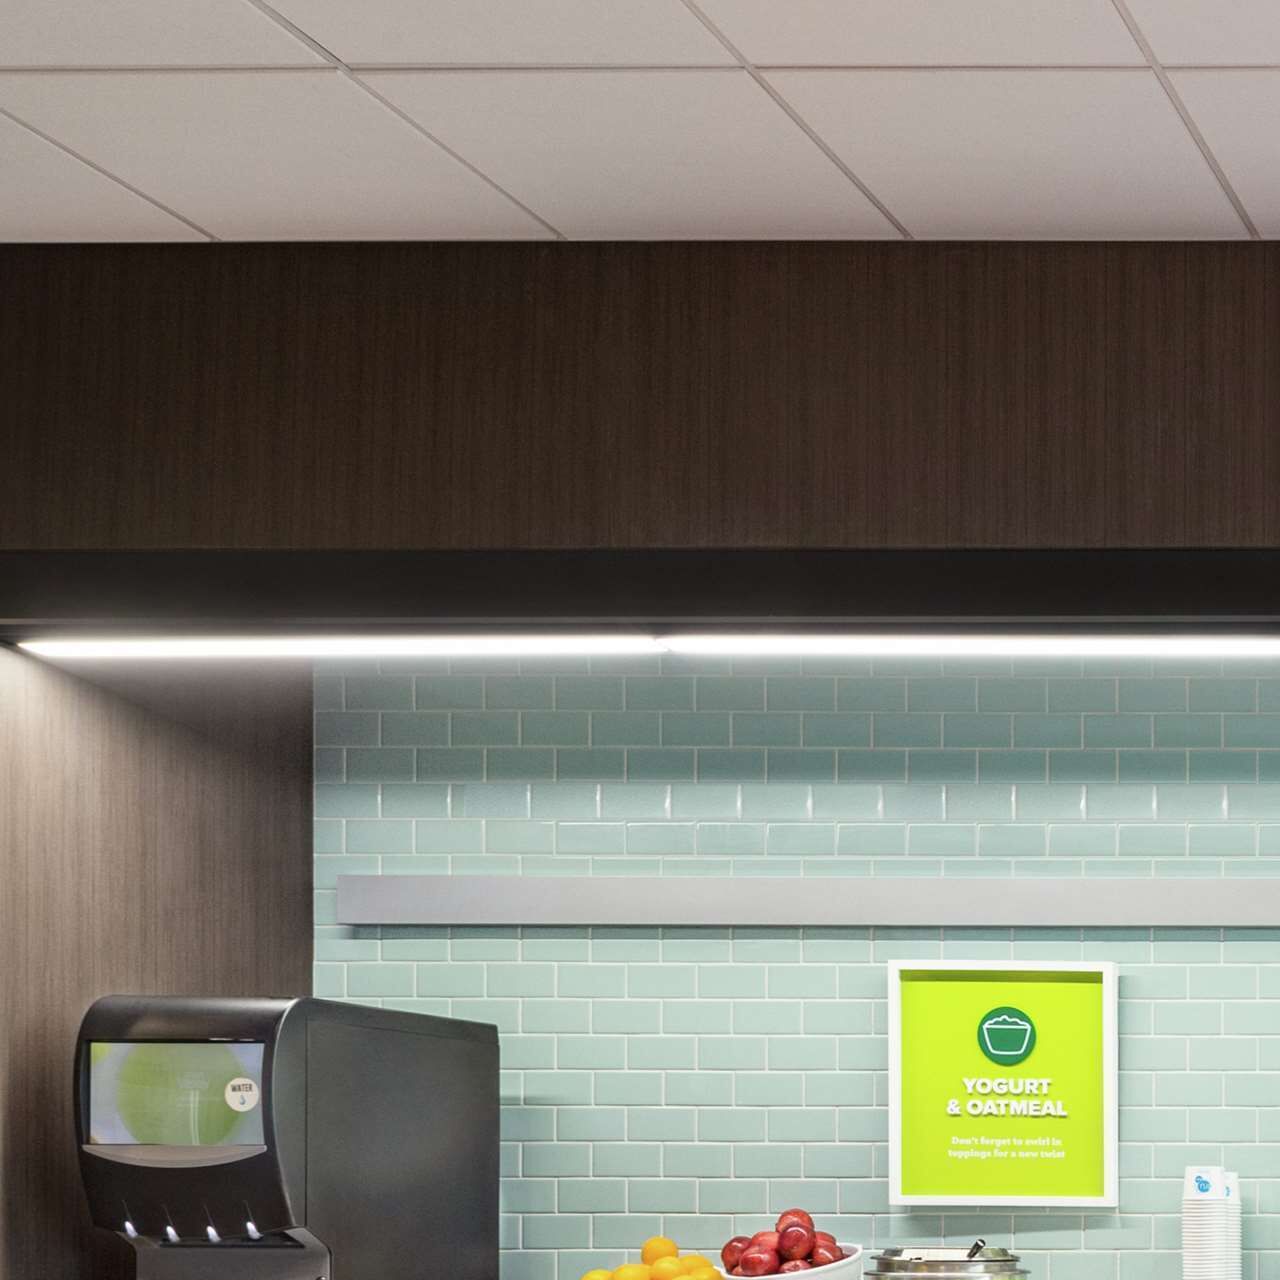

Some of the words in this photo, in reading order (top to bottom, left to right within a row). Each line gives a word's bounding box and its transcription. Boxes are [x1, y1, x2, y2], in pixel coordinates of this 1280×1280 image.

[231, 1083, 252, 1092] WATER
[962, 1077, 1053, 1095] YOGURT
[946, 1098, 962, 1116] &
[965, 1099, 1068, 1118] OATMEAL
